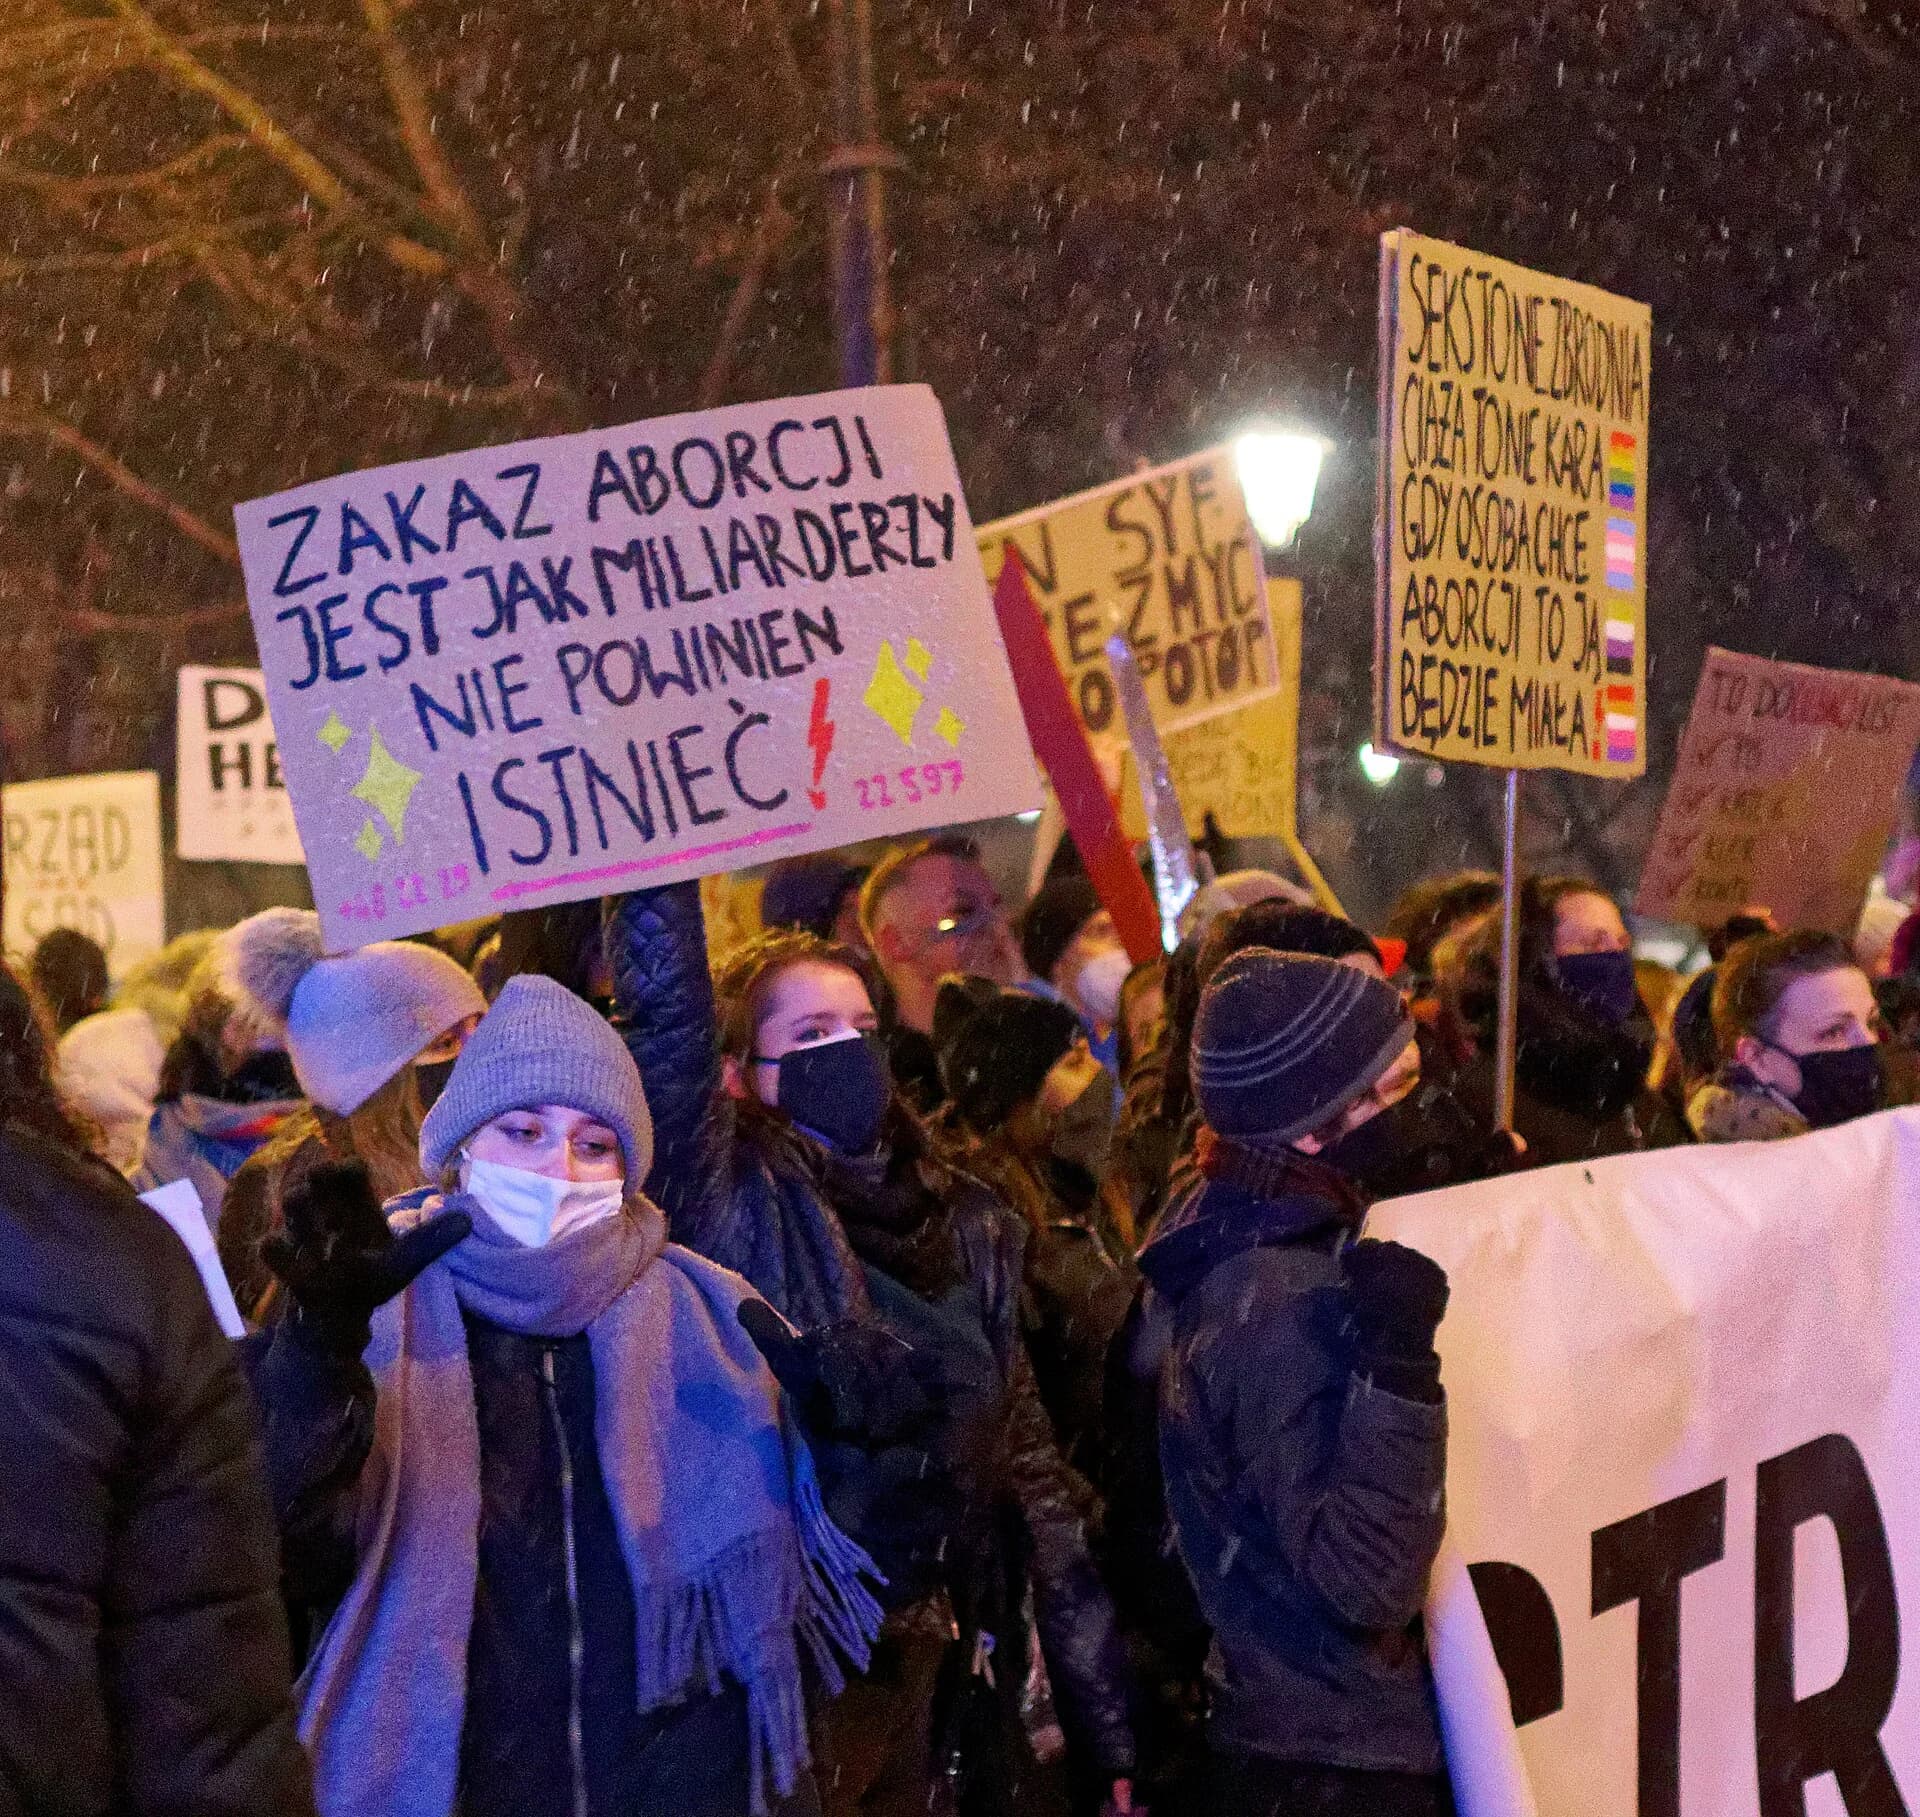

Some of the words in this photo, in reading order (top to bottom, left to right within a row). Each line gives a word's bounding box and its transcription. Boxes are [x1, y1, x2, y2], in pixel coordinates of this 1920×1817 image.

[1408, 253, 1473, 375] SEKS
[1476, 271, 1511, 383] TO
[1513, 291, 1547, 395] NIE
[1550, 297, 1645, 423] ZBRODNIA
[1473, 387, 1501, 481] TO
[1505, 400, 1540, 486] NIE
[1546, 412, 1605, 503] KARA
[268, 463, 552, 597] ZAKAZ
[588, 416, 882, 522] ABORCJI
[1106, 466, 1217, 576] SYF
[1402, 471, 1453, 563] GDY
[1456, 484, 1531, 574] OSOBA
[1535, 502, 1590, 584] CHCE
[276, 576, 448, 690] JEST
[465, 555, 589, 639] JAK
[591, 492, 956, 616] MILIARDERZY
[1401, 571, 1522, 663] ABORCJI
[1535, 585, 1565, 666] TO
[410, 654, 542, 751] NIE
[556, 606, 845, 716] POWINIEN
[1401, 648, 1499, 750] BĘDZIE
[854, 774, 896, 809] 22
[899, 759, 964, 804] 597
